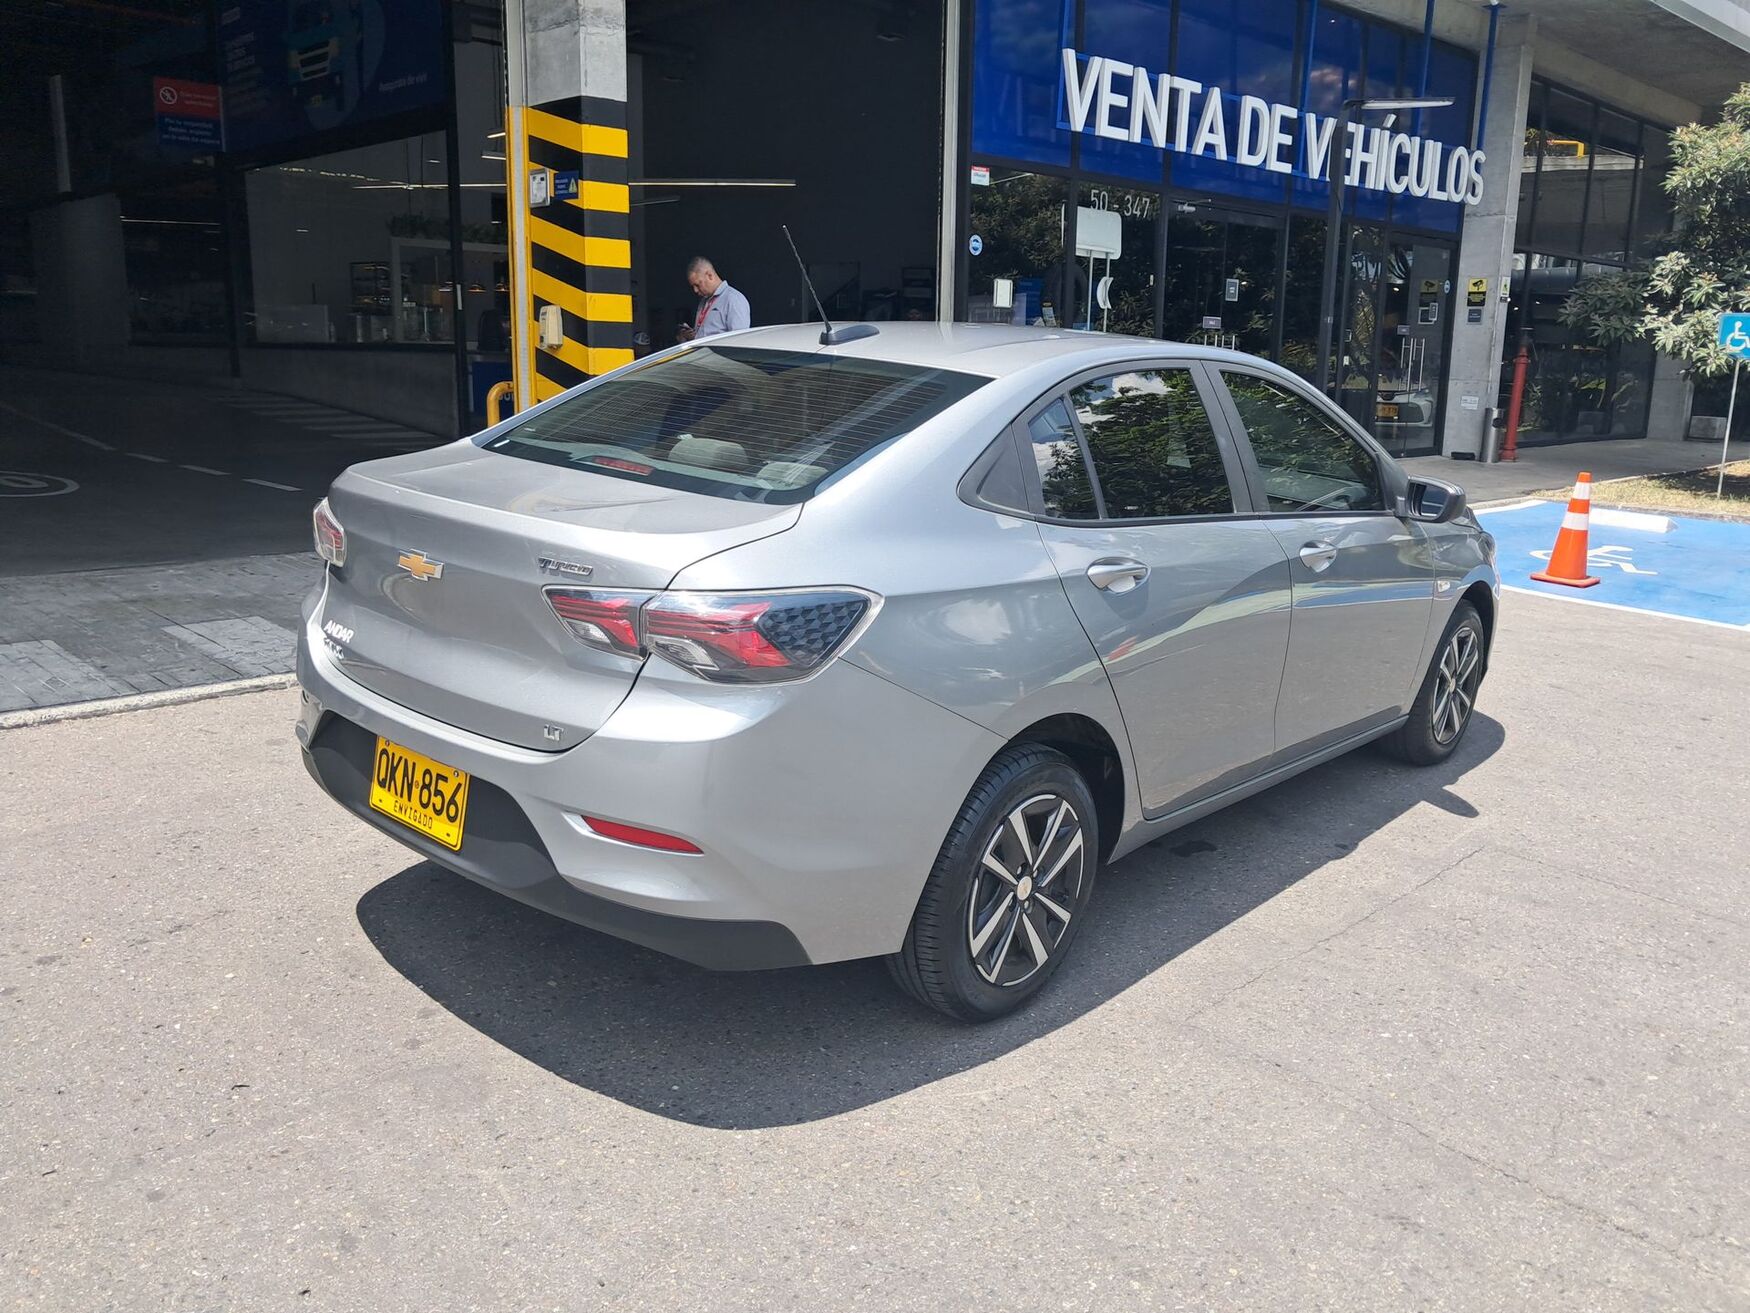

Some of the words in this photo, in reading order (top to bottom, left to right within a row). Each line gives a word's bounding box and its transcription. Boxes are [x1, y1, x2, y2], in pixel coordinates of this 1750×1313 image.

[1062, 47, 1228, 161] VENTA
[1236, 94, 1298, 174] DE
[1090, 189, 1108, 211] 50
[1123, 195, 1150, 219] 347
[543, 724, 565, 742] LT
[376, 748, 417, 802] QKN
[418, 768, 464, 824] 856
[393, 800, 434, 830] ENVIGADO
